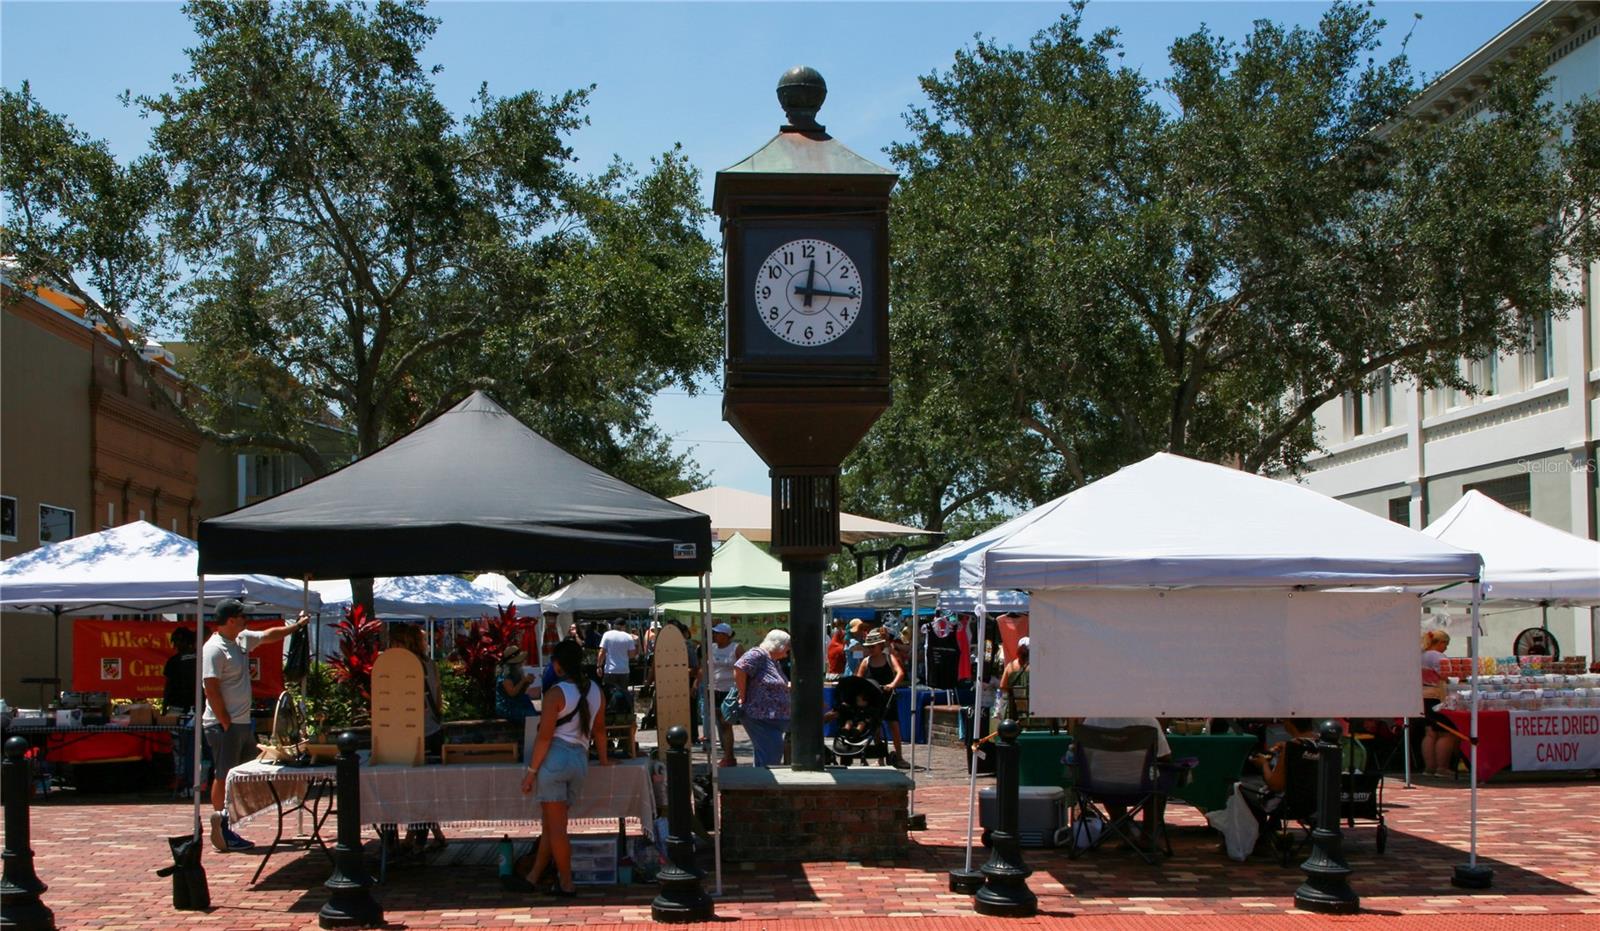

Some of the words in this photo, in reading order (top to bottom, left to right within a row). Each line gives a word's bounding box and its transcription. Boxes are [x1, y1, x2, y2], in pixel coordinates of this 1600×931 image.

[802, 245, 815, 258] 12
[826, 251, 831, 264] 1
[784, 252, 794, 265] 11
[768, 266, 782, 279] 10
[840, 266, 849, 278] 2
[762, 286, 771, 299] 9
[848, 286, 856, 299] 3
[769, 306, 779, 320] 8
[840, 307, 849, 320] 4
[785, 321, 794, 334] 7
[804, 326, 813, 340] 6
[825, 321, 834, 335] 5
[101, 631, 161, 648] Mike's
[1515, 716, 1559, 736] FREEZE
[1562, 714, 1599, 735] DRIED
[1536, 742, 1580, 762] CANDY
